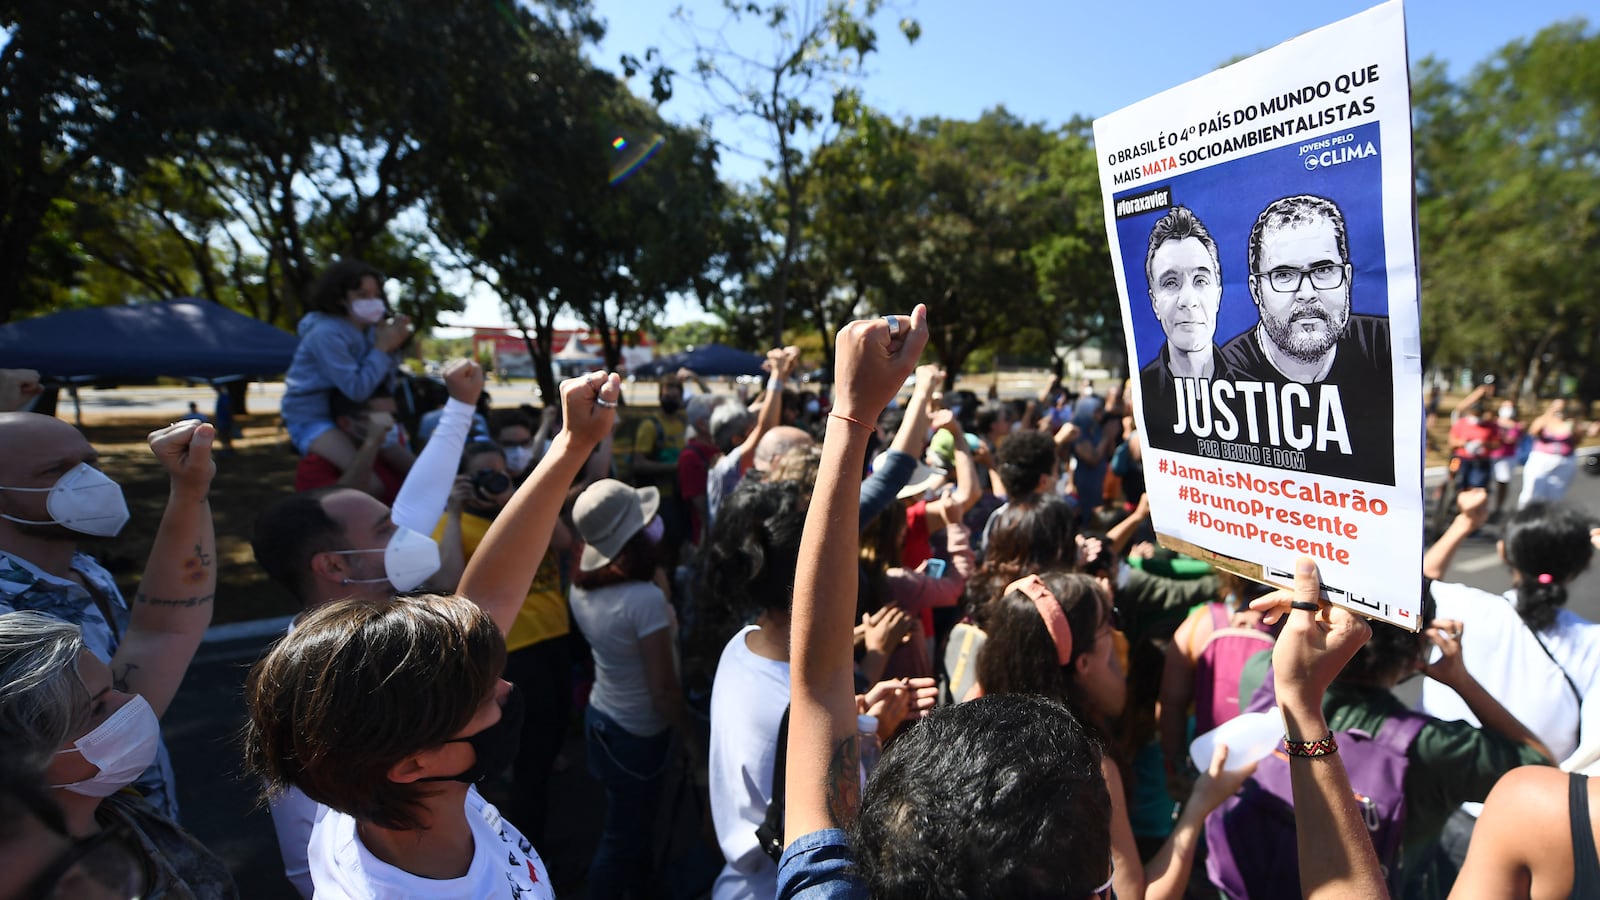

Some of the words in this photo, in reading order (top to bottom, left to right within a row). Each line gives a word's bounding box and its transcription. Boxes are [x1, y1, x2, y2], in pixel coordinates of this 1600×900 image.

[1108, 153, 1116, 166] O
[1117, 140, 1157, 163] BRASIL
[1158, 131, 1166, 150] É
[1168, 132, 1178, 146] O
[1180, 126, 1196, 142] 4º
[1198, 110, 1231, 137] PAÍS
[1233, 105, 1258, 125] DO
[1260, 81, 1331, 114] MUNDO
[1334, 64, 1380, 94] QUE
[1113, 167, 1141, 186] MAIS
[1142, 156, 1177, 177] MATA
[1179, 96, 1376, 167] SOCIOAMBIENTALISTAS
[1298, 140, 1331, 156] JOVENS
[1331, 133, 1355, 146] PELO
[1319, 141, 1378, 167] CLIMA
[1116, 190, 1169, 217] #foraxavier
[1172, 377, 1353, 456] JUSTIÇA
[1197, 438, 1220, 458] POR
[1221, 441, 1261, 464] BRUNO
[1262, 447, 1272, 466] E
[1273, 448, 1307, 471] DOM
[1158, 458, 1389, 516] #JamaisNosCalarão
[1178, 485, 1358, 540] #BrunoPresente
[1188, 509, 1350, 565] #DomPresente
